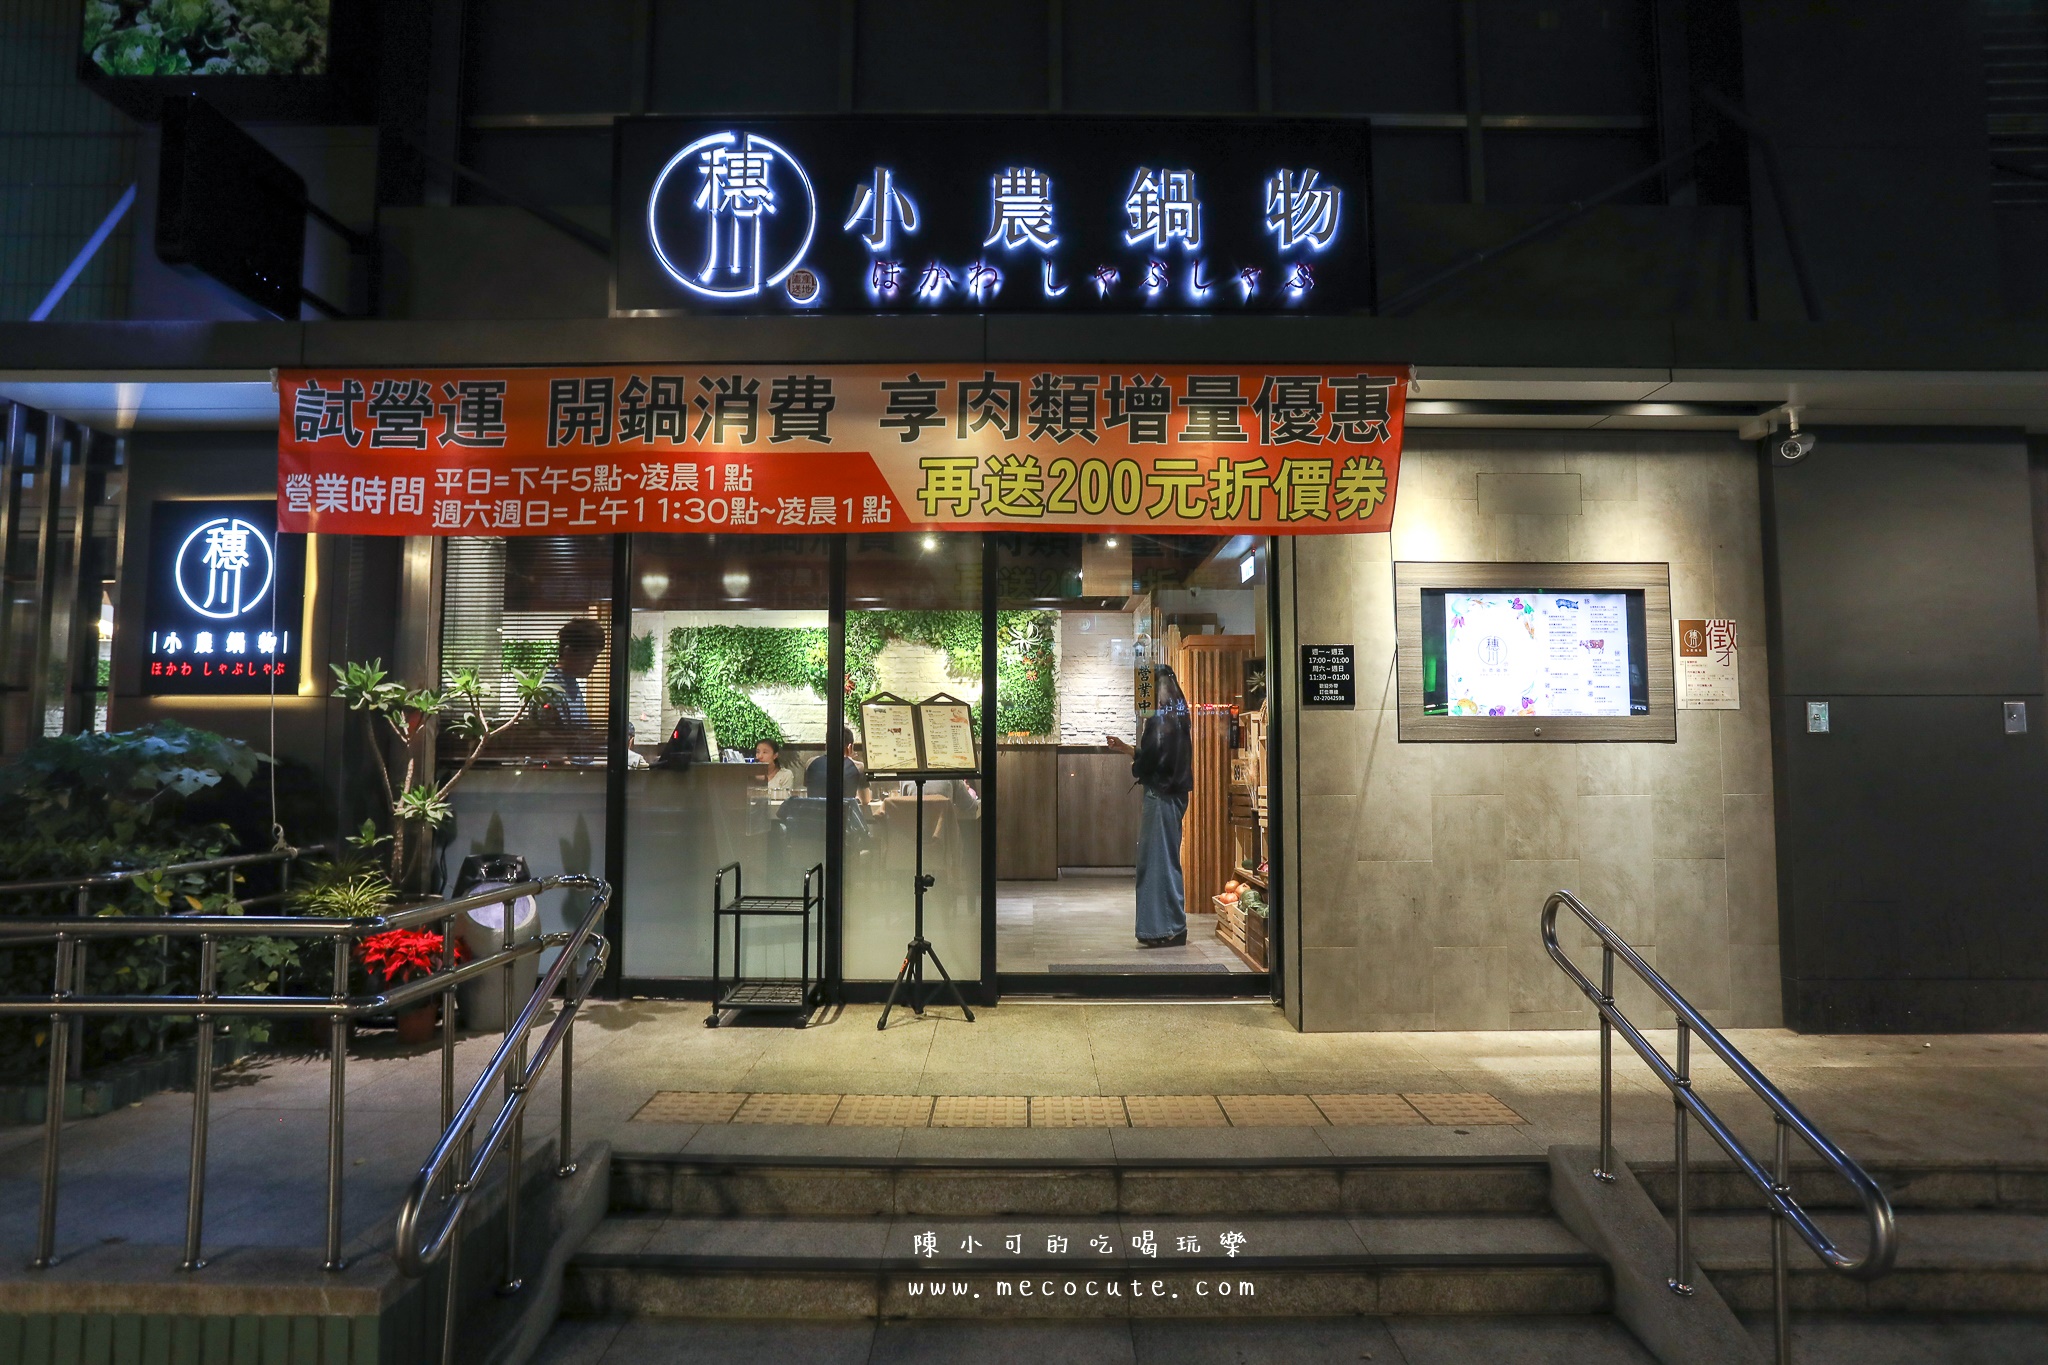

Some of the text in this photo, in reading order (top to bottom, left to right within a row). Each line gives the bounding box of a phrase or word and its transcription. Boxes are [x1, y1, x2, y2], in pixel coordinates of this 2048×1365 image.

[843, 165, 1343, 250] 小農鍋物
[870, 258, 1316, 296] ほかわ しゃぶしゃぶ
[294, 371, 1398, 449] 試營運 開鍋消費 享肉類增量優惠
[285, 472, 426, 516] 營業時間
[434, 463, 753, 495] 平日=下午5點~凌晨1點
[917, 454, 1387, 521] 再送200元折價券
[1137, 666, 1152, 714] 營業中
